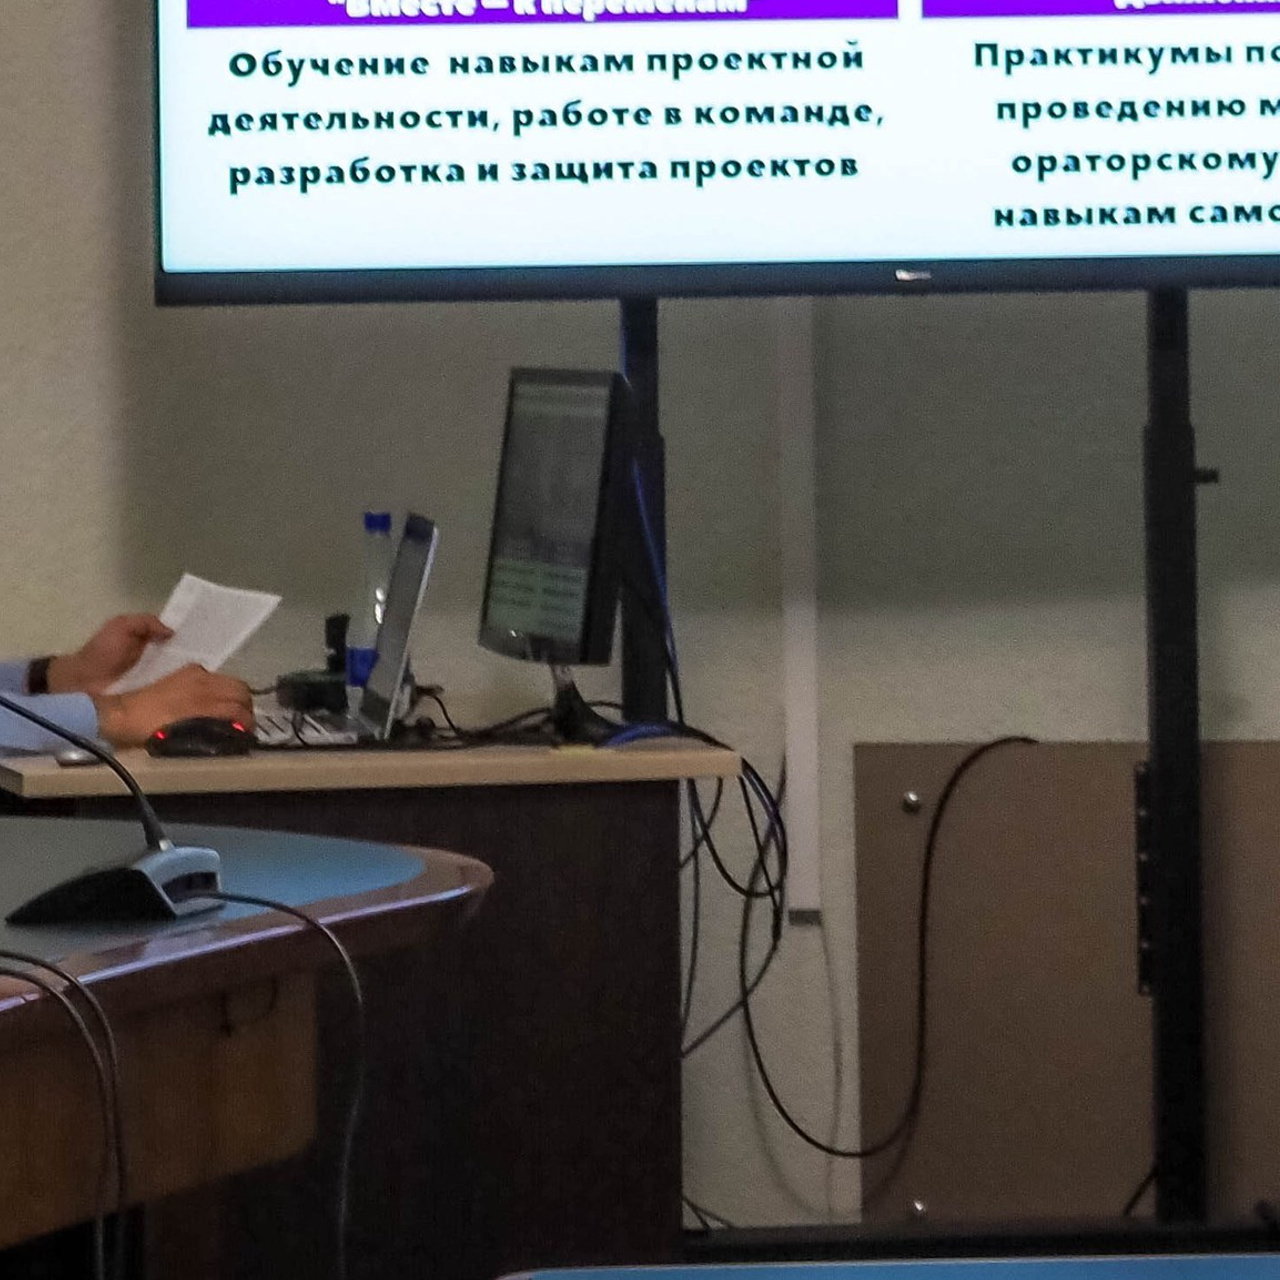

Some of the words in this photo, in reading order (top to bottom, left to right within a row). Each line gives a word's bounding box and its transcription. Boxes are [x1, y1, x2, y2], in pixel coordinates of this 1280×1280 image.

[228, 49, 430, 87] Обучение
[449, 53, 634, 75] навыкам
[647, 39, 864, 81] проектной
[974, 42, 1233, 76] Практикумы
[207, 107, 501, 136] деятельности,
[512, 99, 652, 137] работе
[664, 106, 683, 125] в
[694, 103, 884, 128] команде,
[996, 97, 1246, 130] проведению
[229, 156, 465, 195] разработка
[477, 162, 499, 182] и
[511, 160, 658, 184] защита
[670, 156, 859, 188] проектов
[1011, 150, 1279, 182] ораторскому
[994, 205, 1176, 227] навыкам
